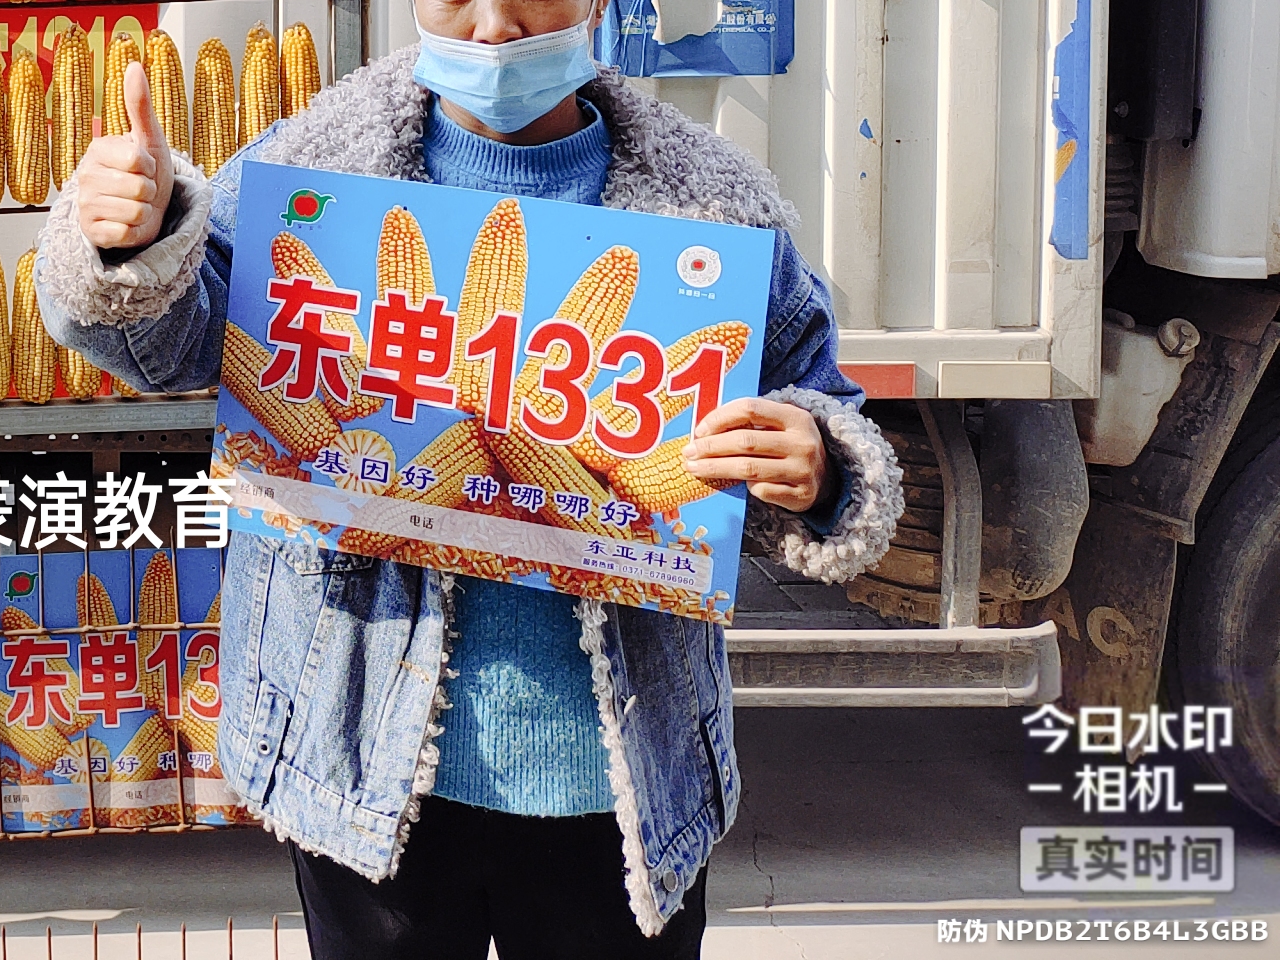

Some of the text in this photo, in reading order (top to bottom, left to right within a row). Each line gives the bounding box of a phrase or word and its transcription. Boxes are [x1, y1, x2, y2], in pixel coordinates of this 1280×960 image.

[257, 274, 729, 460] 东单1331
[239, 480, 276, 500] 经销商
[311, 449, 640, 528] 基因好 种哪哪好
[408, 513, 434, 530] 电话
[583, 539, 697, 575] 东亚科技
[1, 632, 221, 730] 东单13
[53, 756, 140, 776] 基因好
